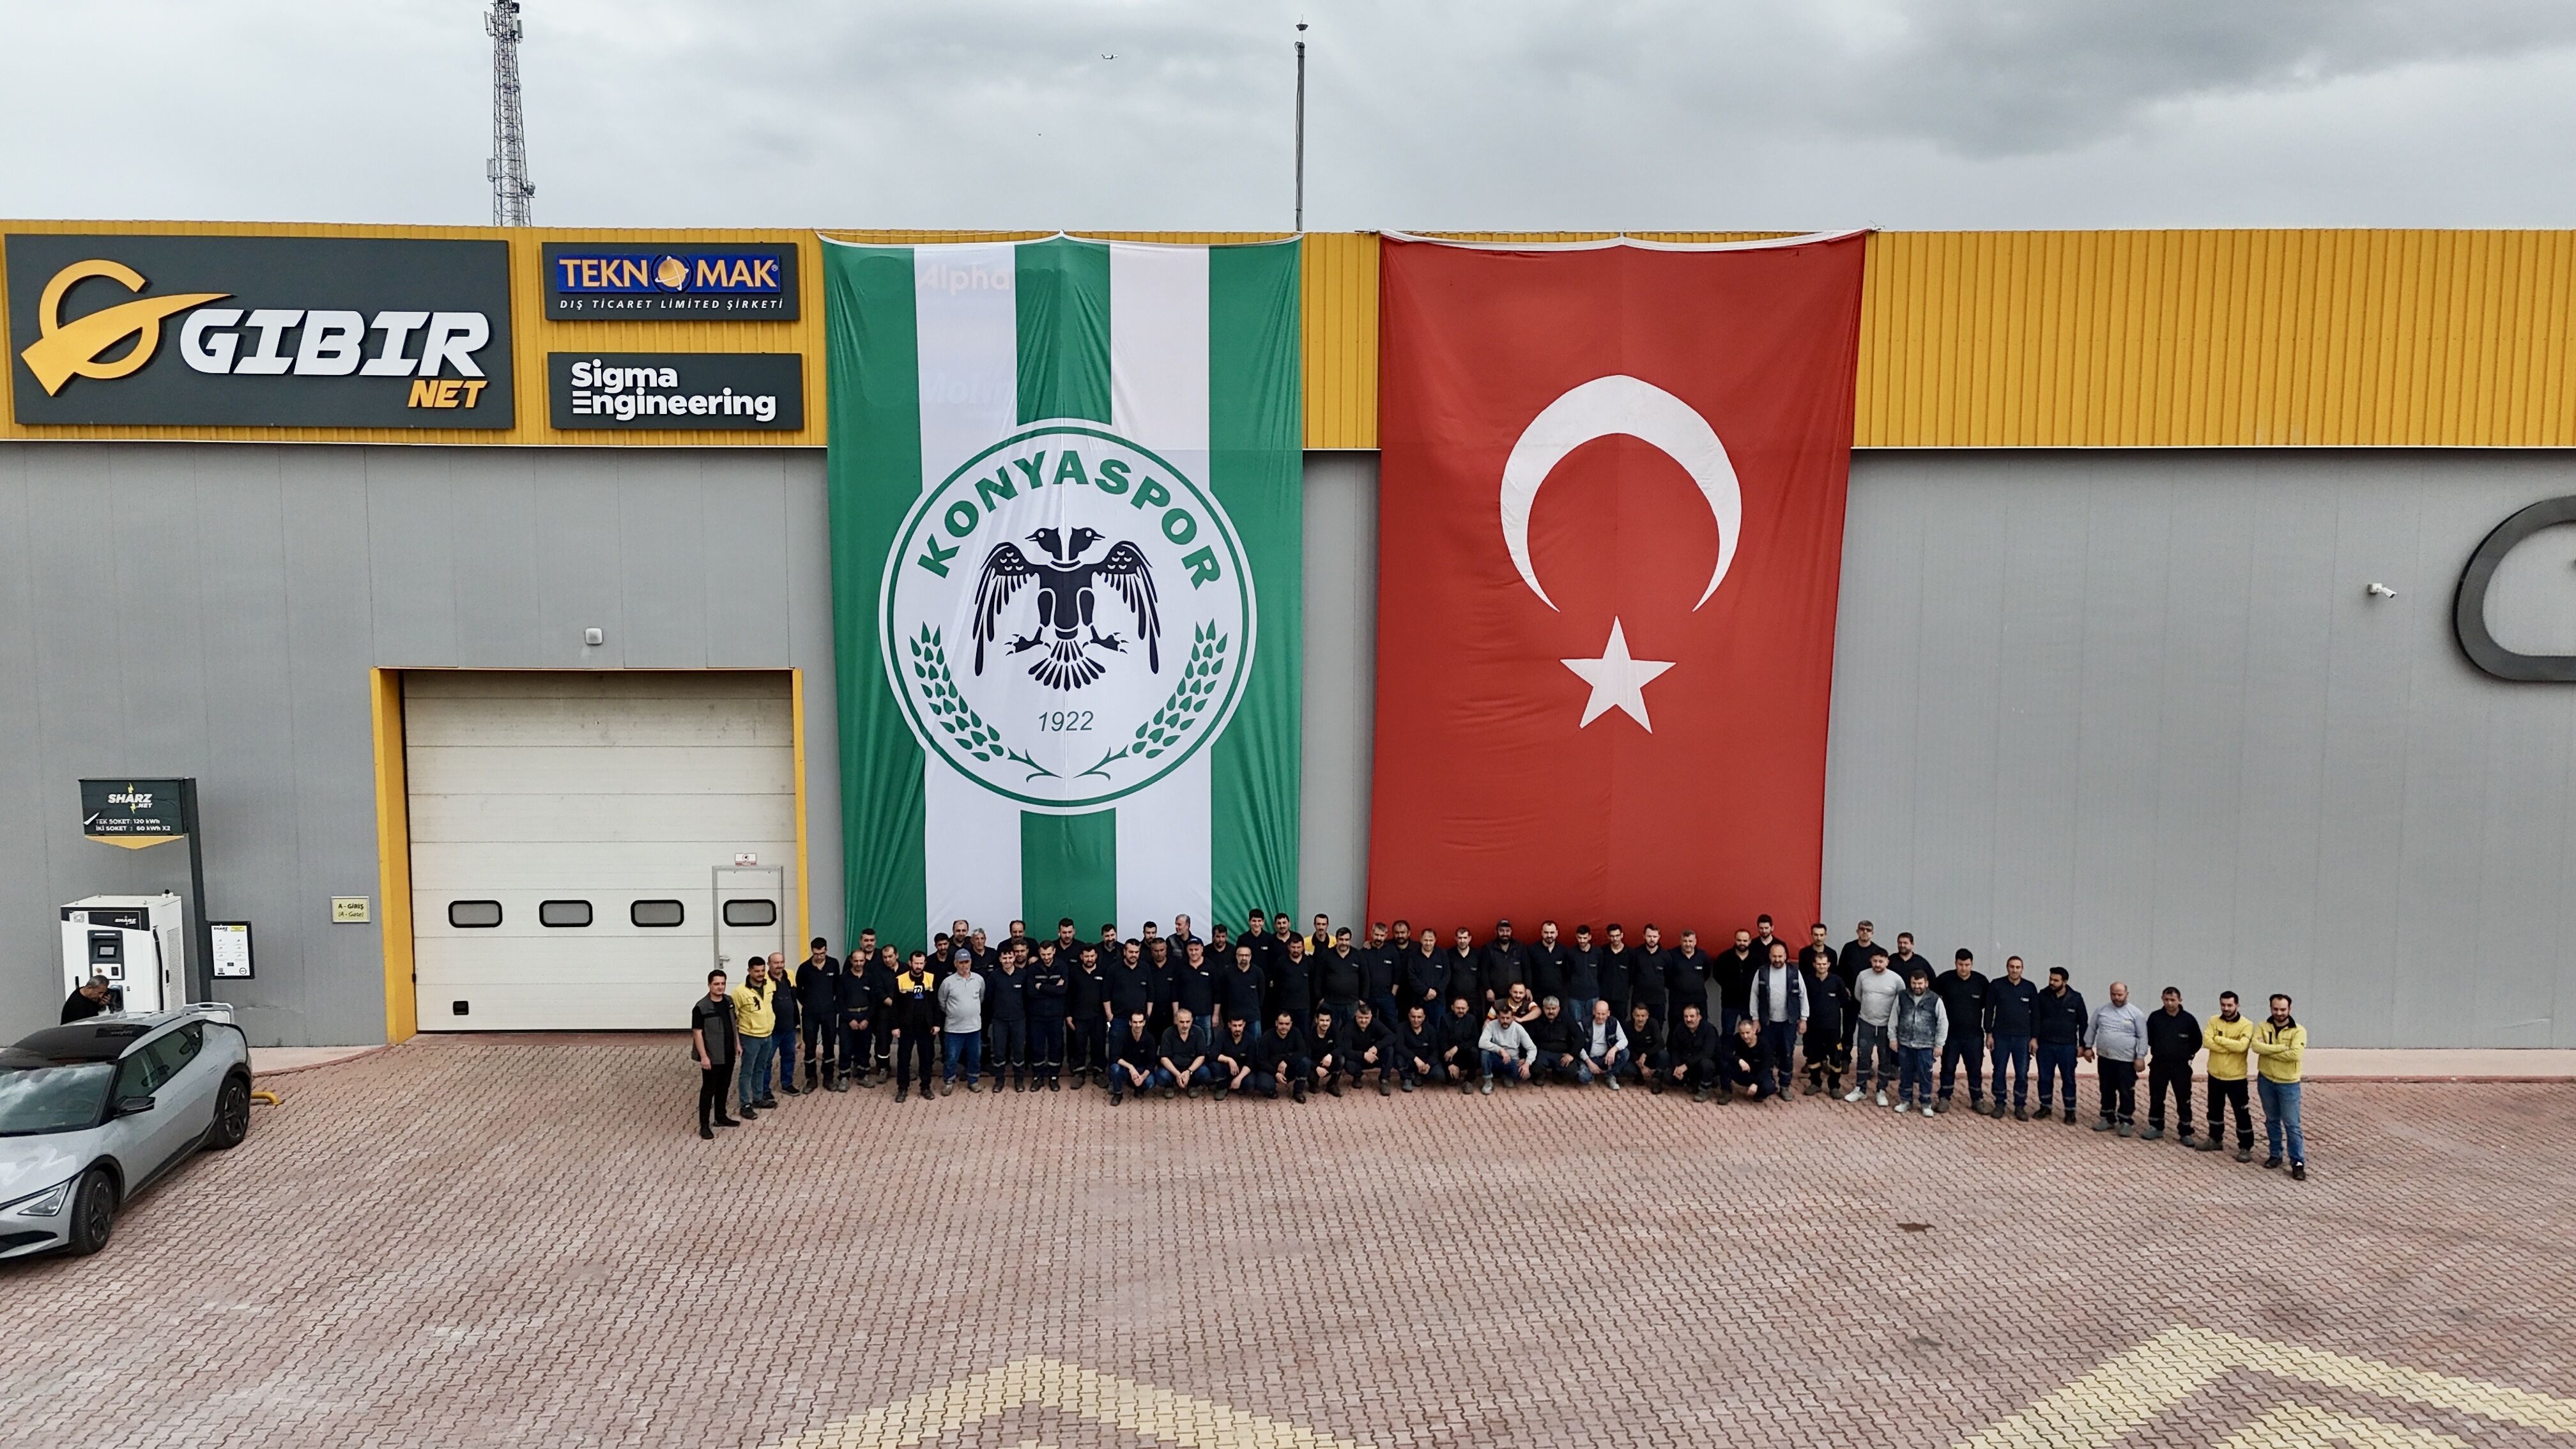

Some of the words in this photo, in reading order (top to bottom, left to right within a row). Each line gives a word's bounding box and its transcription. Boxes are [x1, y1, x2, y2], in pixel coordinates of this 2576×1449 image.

[560, 300, 583, 310] DIŞ
[592, 298, 652, 309] TİCARET
[661, 298, 719, 309] LİMİTED
[726, 298, 783, 311] ŞİRKETİ
[180, 309, 491, 377] GIBIR
[571, 358, 678, 393] Sigma
[408, 380, 487, 409] NET
[572, 387, 776, 422] Engineering
[917, 450, 1222, 590] KONYASPOR
[1038, 710, 1094, 732] 1922
[108, 793, 153, 804] SHARZ
